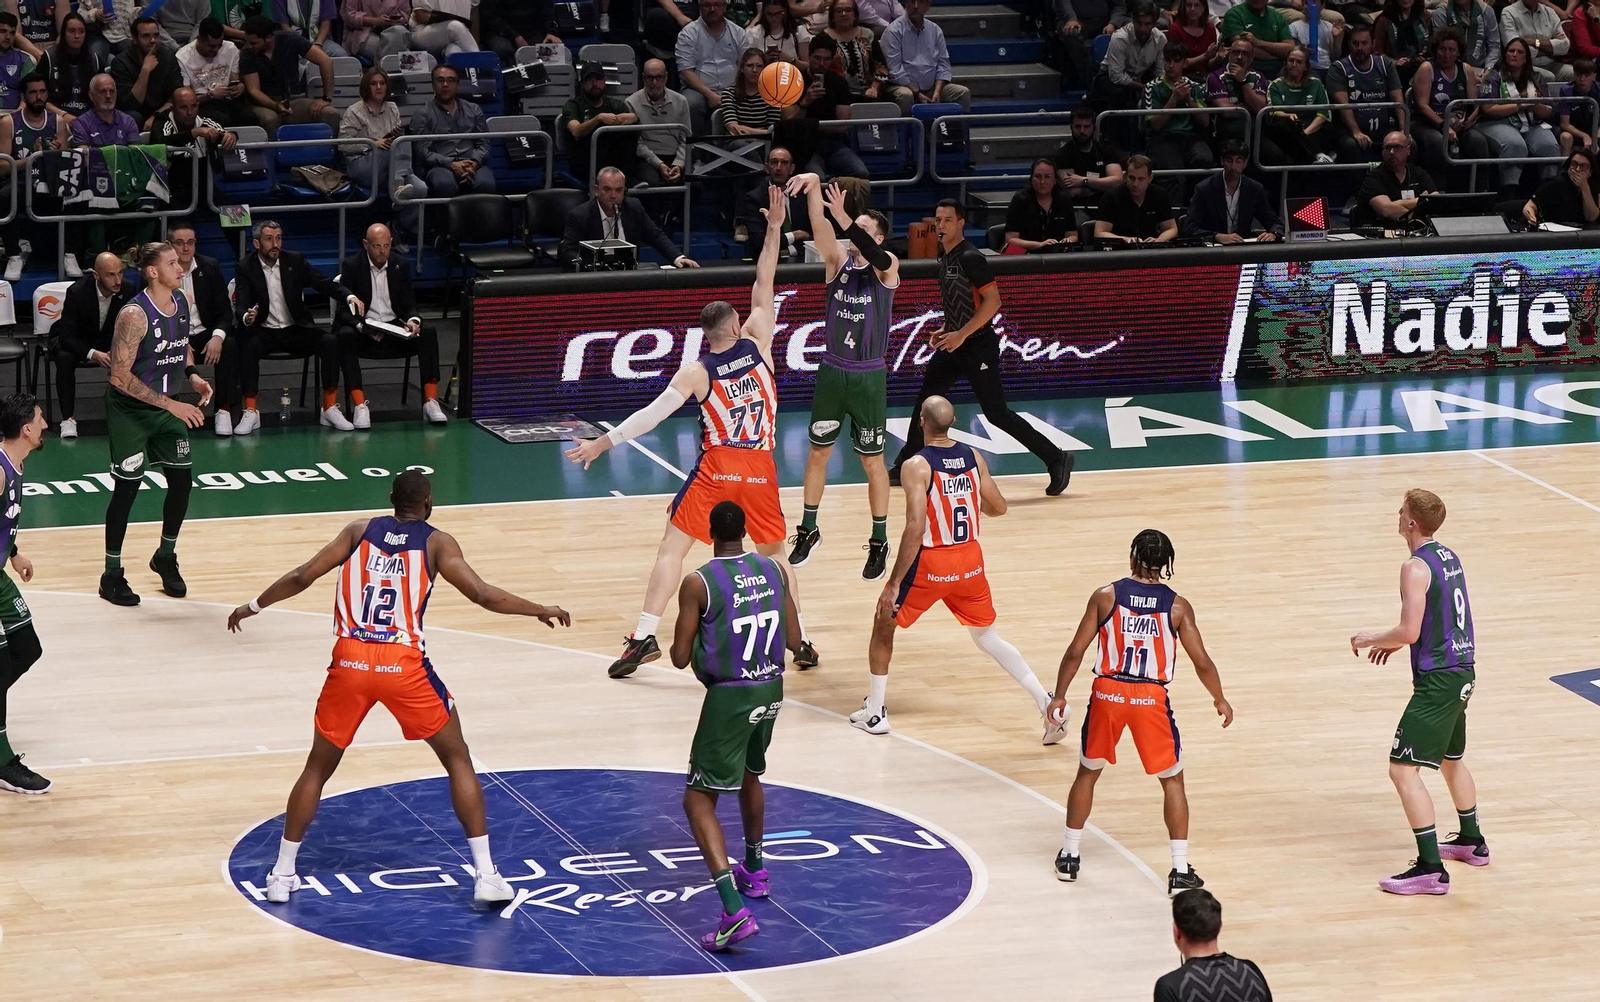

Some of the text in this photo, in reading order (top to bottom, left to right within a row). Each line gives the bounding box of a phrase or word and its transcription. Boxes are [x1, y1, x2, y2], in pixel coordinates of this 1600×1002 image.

[1368, 117, 1379, 131] 11
[1332, 268, 1571, 357] Nadie
[844, 331, 856, 349] 4
[162, 373, 168, 393] 1
[724, 376, 762, 400] LEYMA
[728, 398, 766, 440] 77
[504, 426, 574, 436] acb
[713, 473, 768, 485] Nordés ancín
[943, 476, 973, 495] LEYMA
[953, 505, 970, 544] 6
[367, 554, 406, 577] LEYMA
[734, 574, 768, 589] Sima
[927, 573, 960, 583] Nordés
[361, 584, 398, 627] 12
[1129, 595, 1158, 608] TAYLOR
[1453, 588, 1466, 630] 9
[732, 610, 780, 662] 77
[1121, 615, 1160, 637] LEYMA
[339, 658, 403, 674] Nordés ancín
[1121, 645, 1149, 678] 11
[1096, 691, 1156, 706] Nordés ancín
[500, 878, 718, 919] Resor
